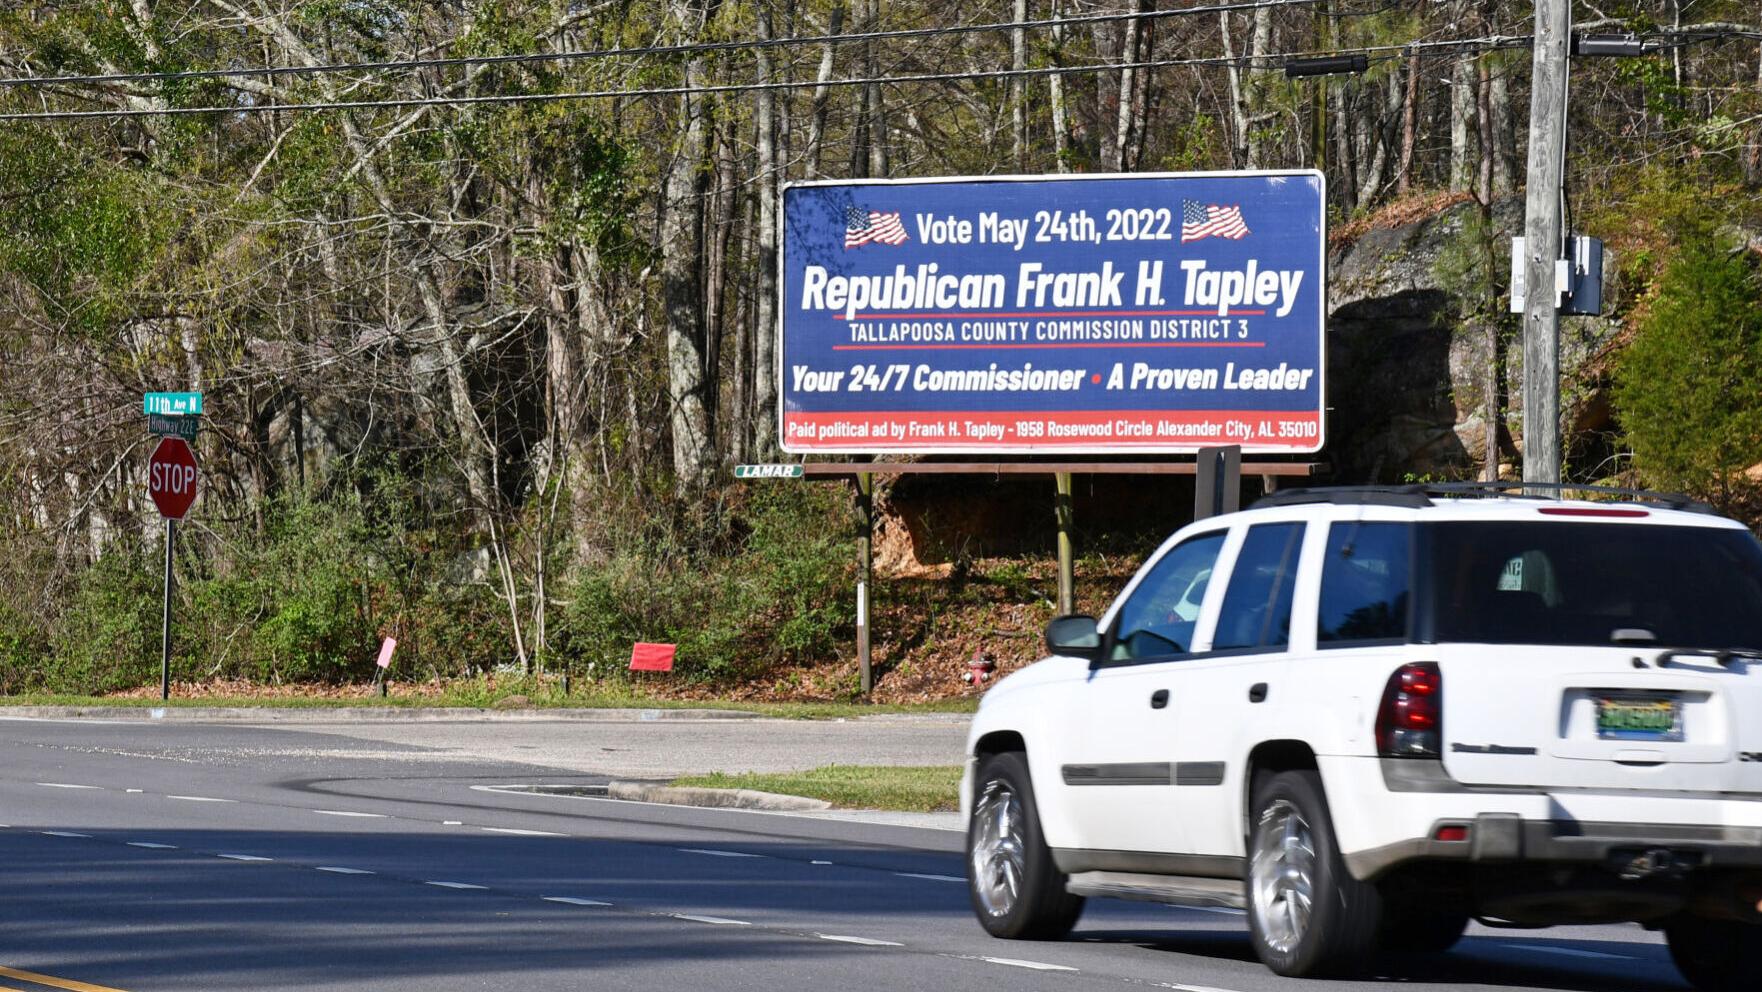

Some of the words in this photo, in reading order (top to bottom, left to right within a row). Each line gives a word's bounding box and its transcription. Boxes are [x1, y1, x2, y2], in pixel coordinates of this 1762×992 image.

[916, 212, 972, 244] Vote
[979, 212, 1029, 251] May
[1035, 210, 1101, 244] 24th,
[1106, 208, 1172, 240] 2022
[801, 262, 1005, 320] Republican
[1016, 261, 1124, 308] Frank
[1135, 261, 1165, 305] H.
[1180, 259, 1304, 318] Tapley
[849, 322, 955, 342] TALLAPOOSA
[961, 321, 1029, 341] COUNTY
[1036, 320, 1143, 340] COMMISSION
[1150, 318, 1231, 339] DISTRICT
[1238, 319, 1248, 338] 3
[792, 365, 844, 392] Your
[848, 365, 910, 392] 24/7
[913, 362, 1086, 391] Commissioner
[1106, 363, 1123, 390] A
[1130, 363, 1218, 391] Proven
[1223, 362, 1313, 391] Leader
[150, 396, 170, 414] 11th
[174, 399, 187, 410] Ave
[190, 396, 197, 412] N
[151, 416, 178, 433] Highway
[788, 421, 816, 438] Paid
[818, 421, 869, 441] political
[872, 421, 888, 437] ad
[891, 421, 906, 441] by
[909, 421, 945, 437] Frank
[948, 421, 961, 437] H.
[964, 421, 1005, 441] Tapley
[1016, 421, 1044, 437] 1958
[1048, 420, 1112, 437] Rosewood
[1116, 420, 1153, 437] Circle
[1156, 420, 1222, 437] Alexander
[1226, 420, 1254, 441] City,
[1258, 421, 1275, 437] AL
[1278, 420, 1317, 438] 35010
[152, 461, 195, 495] STOP
[743, 465, 795, 478] LAMAR
